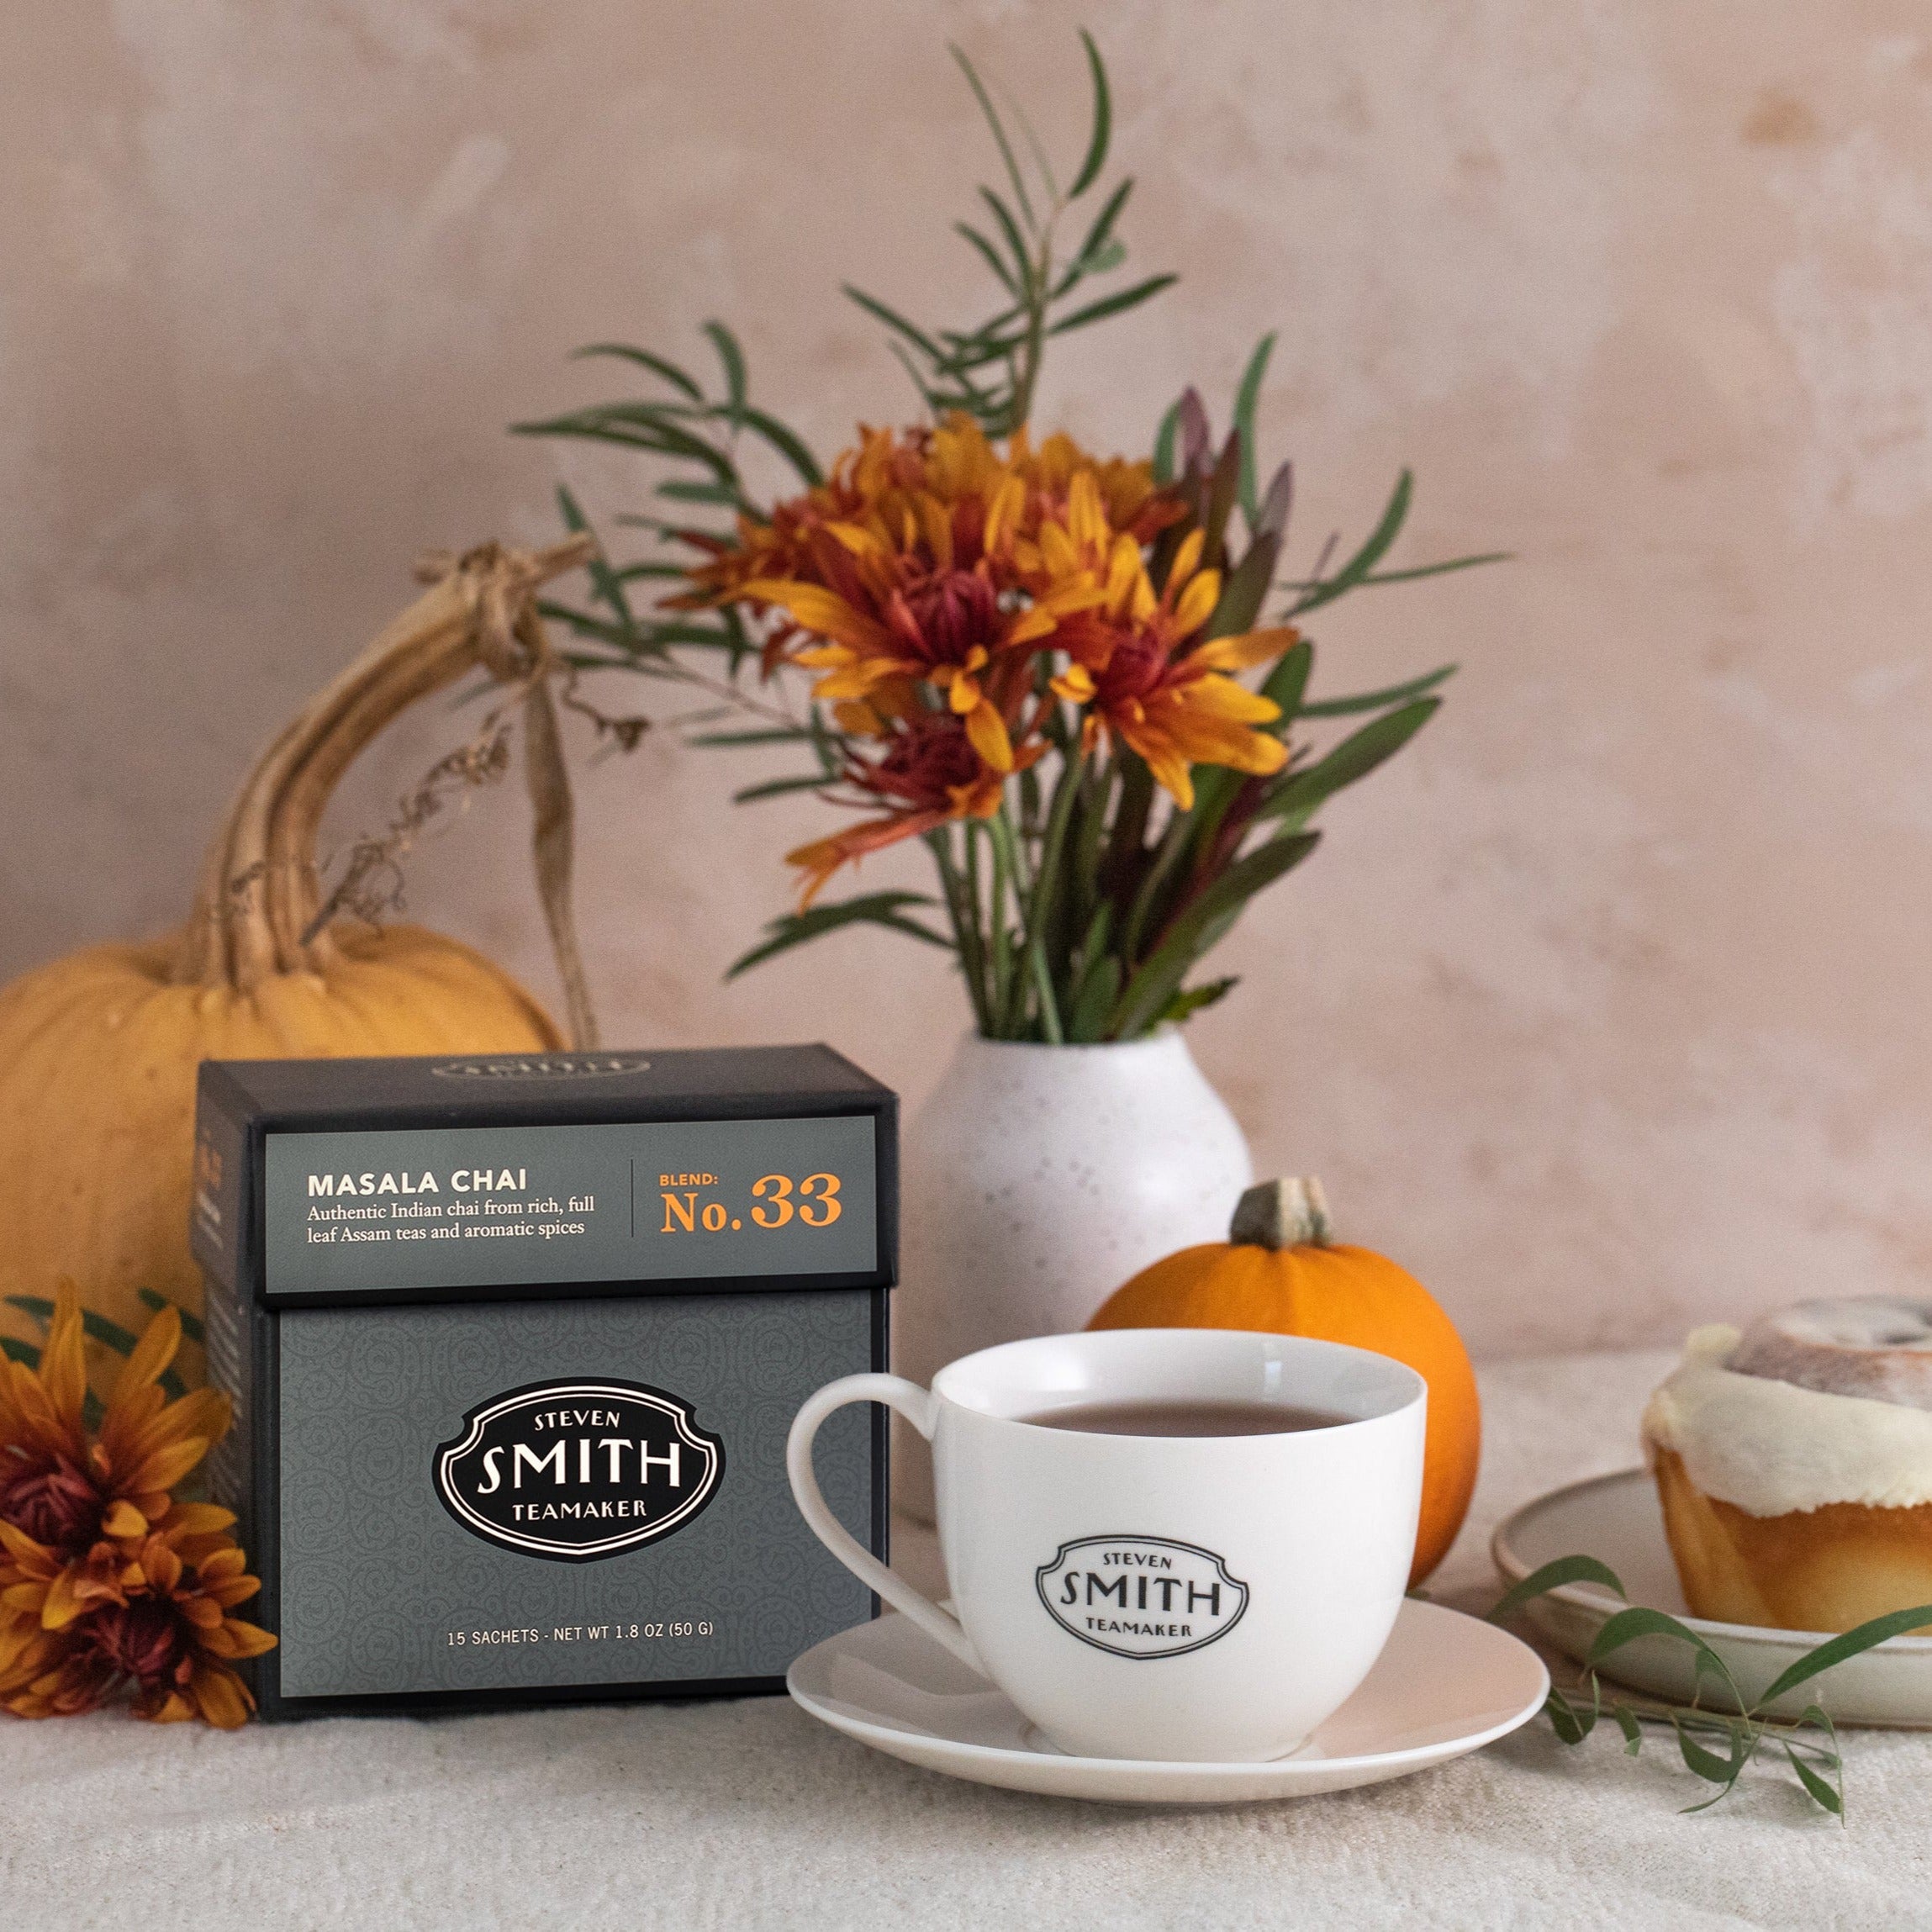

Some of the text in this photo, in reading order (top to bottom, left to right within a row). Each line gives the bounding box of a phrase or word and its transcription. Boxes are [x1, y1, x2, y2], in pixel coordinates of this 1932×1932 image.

[308, 1168, 527, 1197] MASALA CHAI
[659, 1174, 718, 1186] BLEND:
[307, 1196, 595, 1222] Authentic Indian chai from rich, full
[660, 1172, 842, 1233] No. 33
[306, 1219, 585, 1243] leaf Assam teas and aromatic spices
[534, 1409, 620, 1432] STEVEN
[477, 1438, 680, 1495] SMITH
[512, 1500, 647, 1522] TEAMAKER
[1103, 1553, 1172, 1570] STEVEN
[1060, 1570, 1221, 1616] SMITH
[447, 1632, 466, 1646] 15
[472, 1628, 540, 1645] SACHETS
[554, 1627, 583, 1641] NET
[588, 1626, 610, 1639] WT
[615, 1624, 639, 1639] 1.8
[644, 1623, 664, 1638] OZ
[668, 1623, 693, 1637] (50
[698, 1621, 714, 1636] G)
[1085, 1617, 1192, 1637] TEAMAKER
